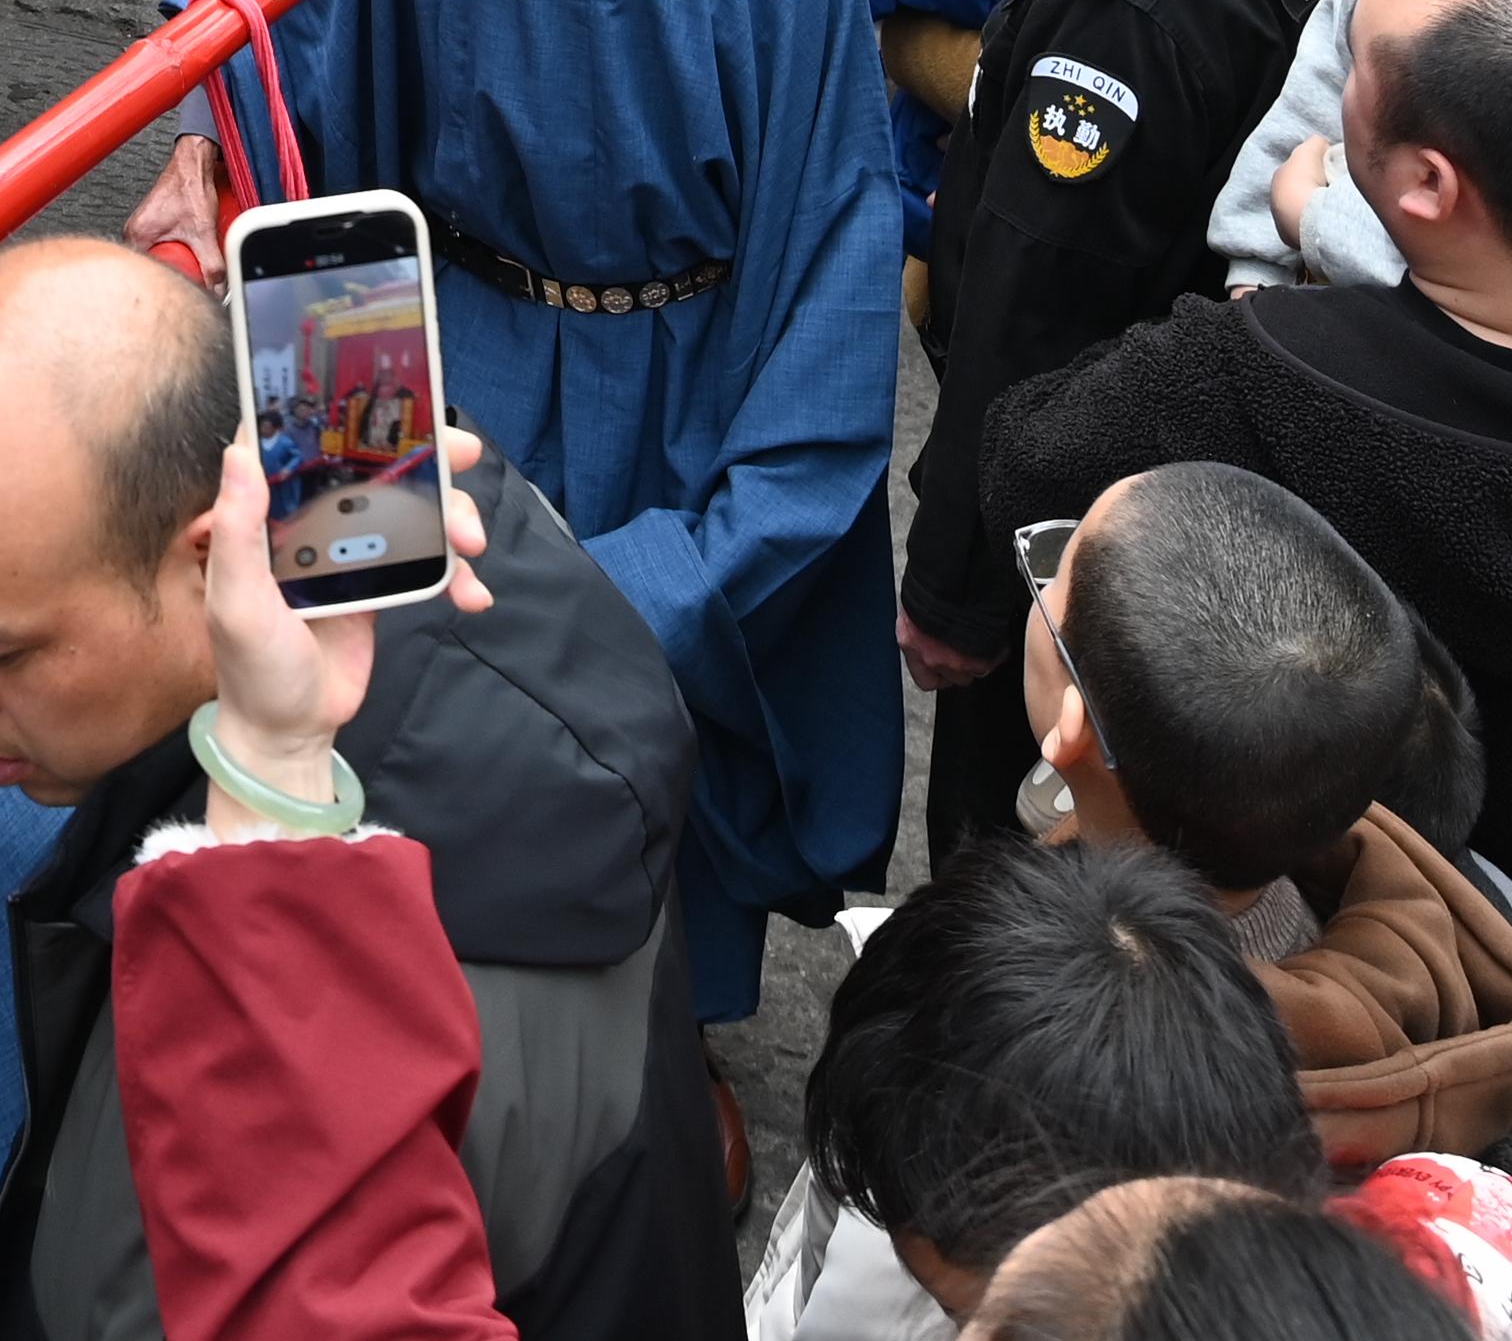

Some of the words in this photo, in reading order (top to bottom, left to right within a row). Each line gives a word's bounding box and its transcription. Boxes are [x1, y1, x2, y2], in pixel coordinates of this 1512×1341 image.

[1050, 60, 1082, 81] ZHI
[1092, 75, 1127, 103] QIN
[1042, 104, 1101, 150] 执勤
